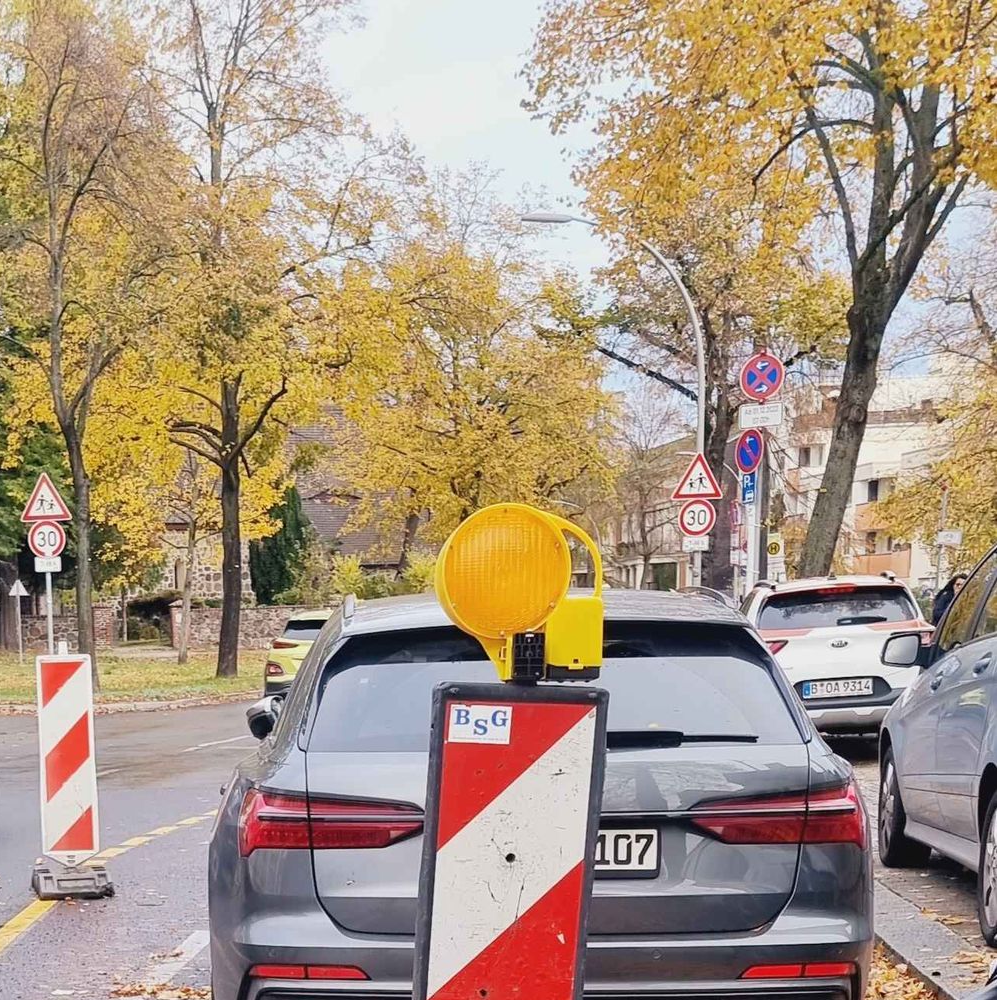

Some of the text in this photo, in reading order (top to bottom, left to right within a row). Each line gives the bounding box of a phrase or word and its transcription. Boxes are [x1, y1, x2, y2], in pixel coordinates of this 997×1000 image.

[687, 509, 707, 526] 30
[37, 531, 57, 547] 30
[811, 683, 818, 694] B
[843, 680, 870, 692] 9314
[454, 708, 508, 736] BSG
